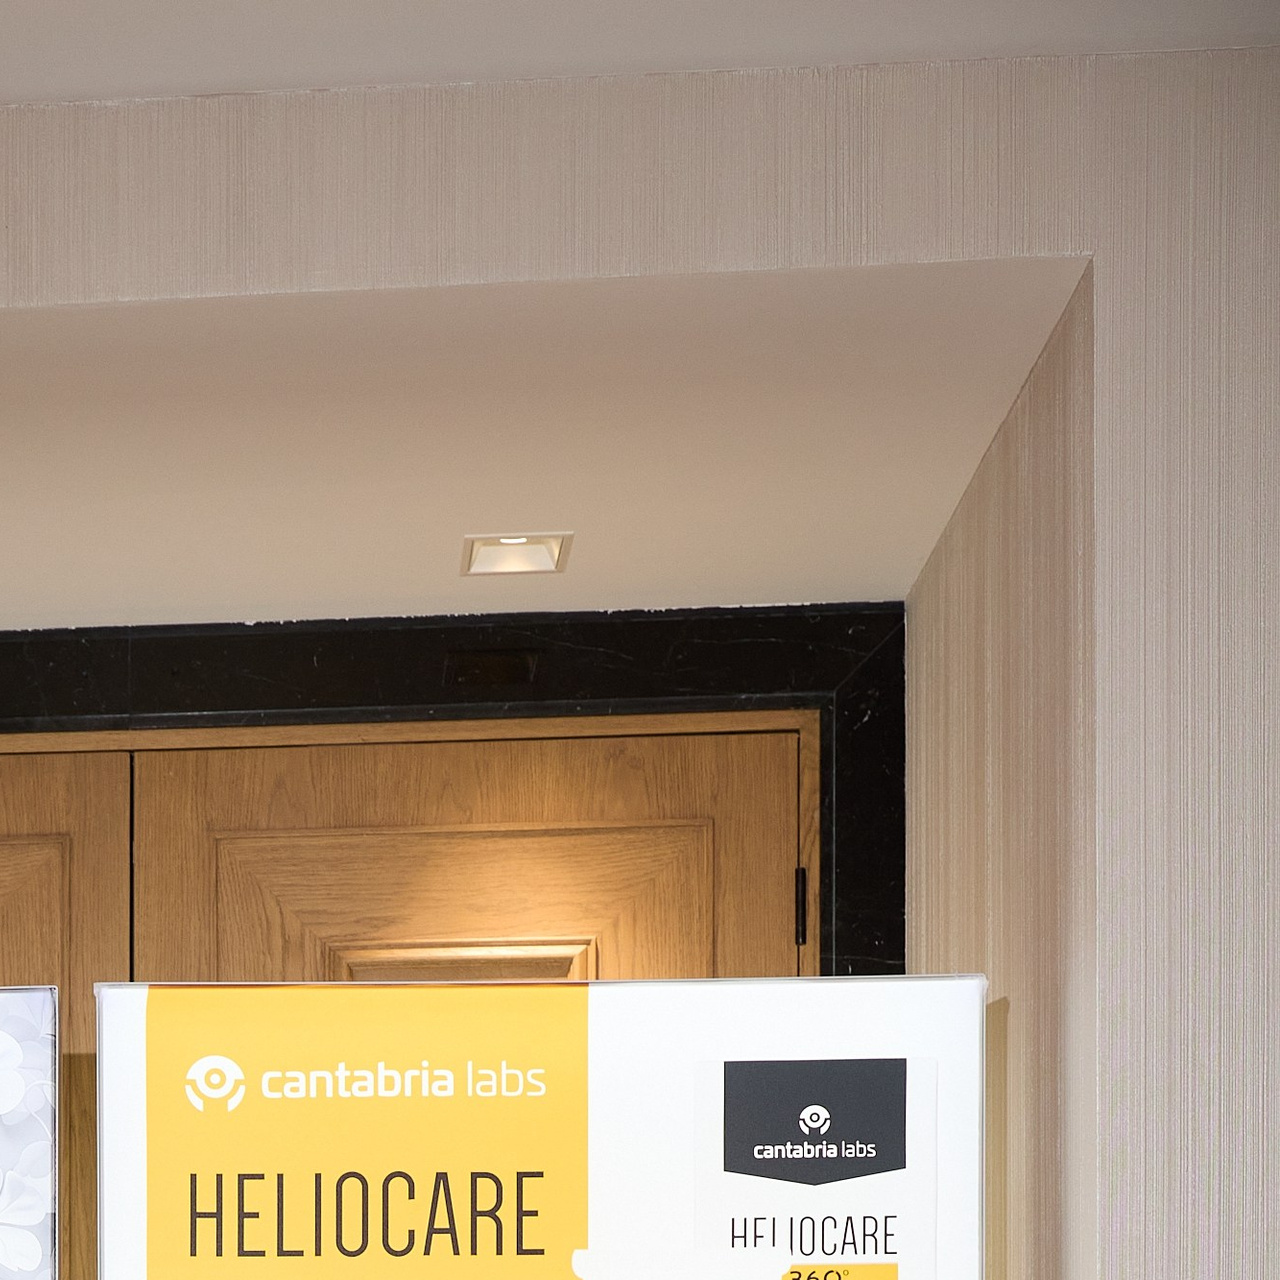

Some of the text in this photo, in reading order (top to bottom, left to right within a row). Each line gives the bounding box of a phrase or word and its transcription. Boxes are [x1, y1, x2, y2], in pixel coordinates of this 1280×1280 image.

[261, 1060, 546, 1099] cantabria labs
[753, 1140, 877, 1160] cantabria labs
[190, 1171, 545, 1257] HELIOCARE
